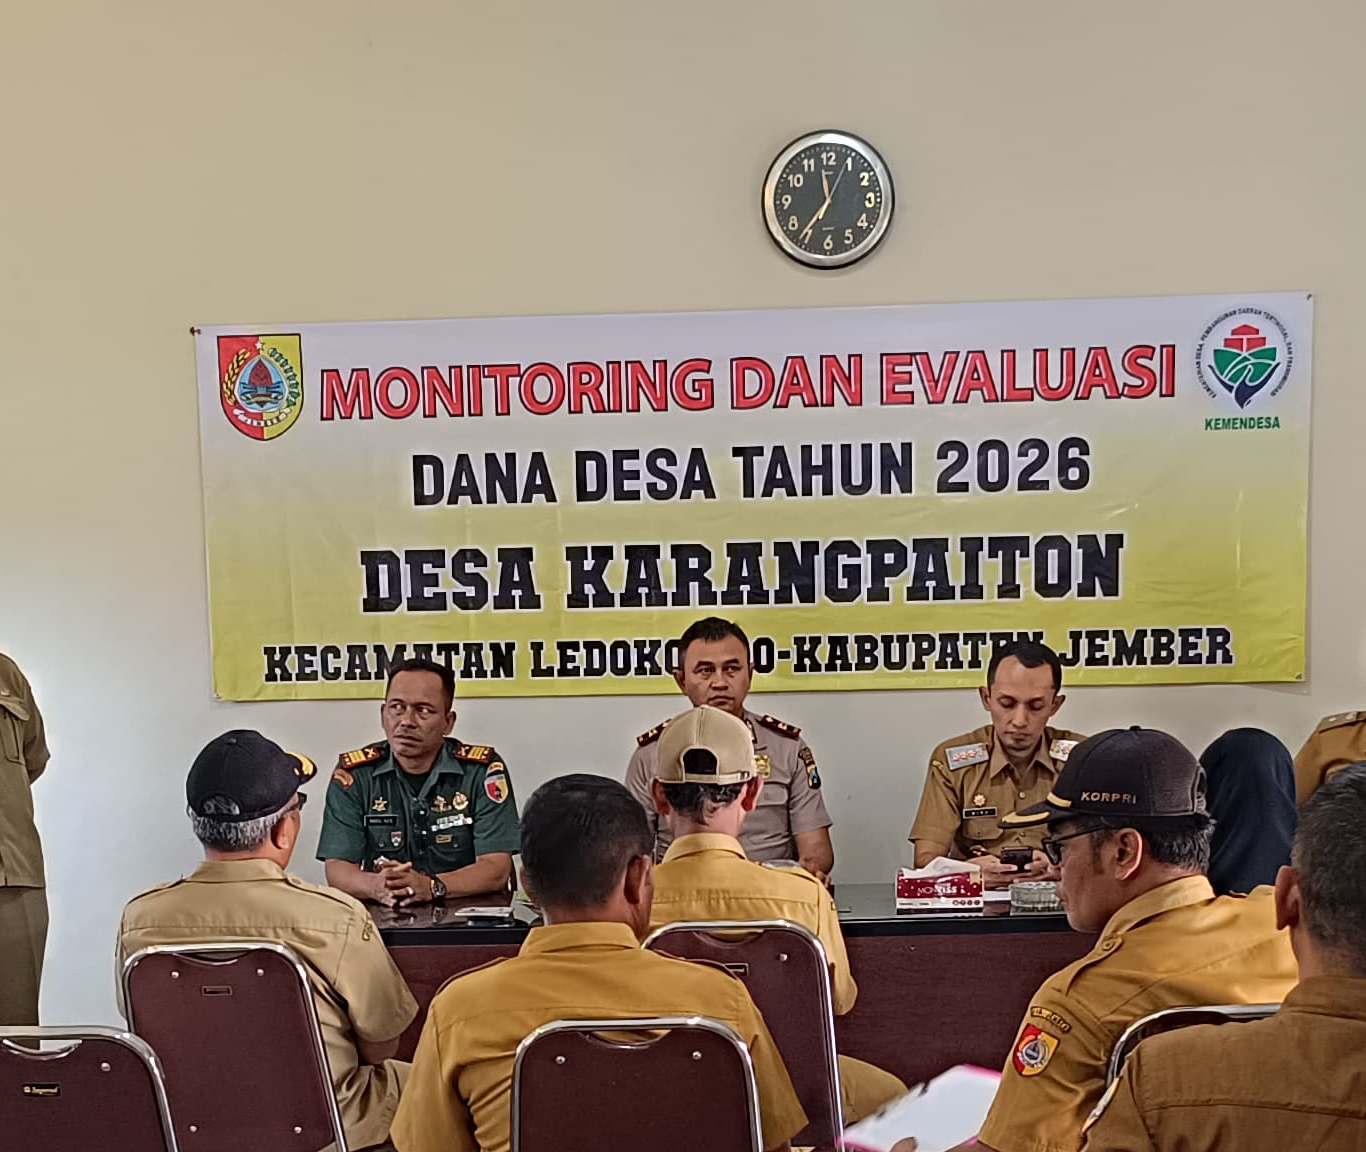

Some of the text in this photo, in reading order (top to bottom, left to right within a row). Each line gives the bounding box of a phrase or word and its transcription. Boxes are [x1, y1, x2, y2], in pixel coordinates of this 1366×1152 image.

[803, 159, 815, 172] 11
[821, 152, 836, 165] 12
[845, 157, 852, 171] 1
[787, 174, 803, 188] 10
[859, 172, 870, 186] 2
[782, 195, 792, 210] 9
[865, 192, 875, 208] 3
[788, 215, 798, 230] 8
[857, 213, 868, 229] 4
[804, 228, 813, 244] 7
[823, 235, 833, 250] 6
[844, 229, 853, 244] 5
[319, 344, 1176, 422] MONITORING DAN EVALUASI
[1204, 416, 1281, 431] KEMENDESA
[412, 436, 1091, 506] DANA DESA TAHUN 2026
[360, 533, 1124, 612] DESA KARANGPAITON
[1058, 628, 1233, 668] JEMBER
[1080, 791, 1137, 804] KORPRI
